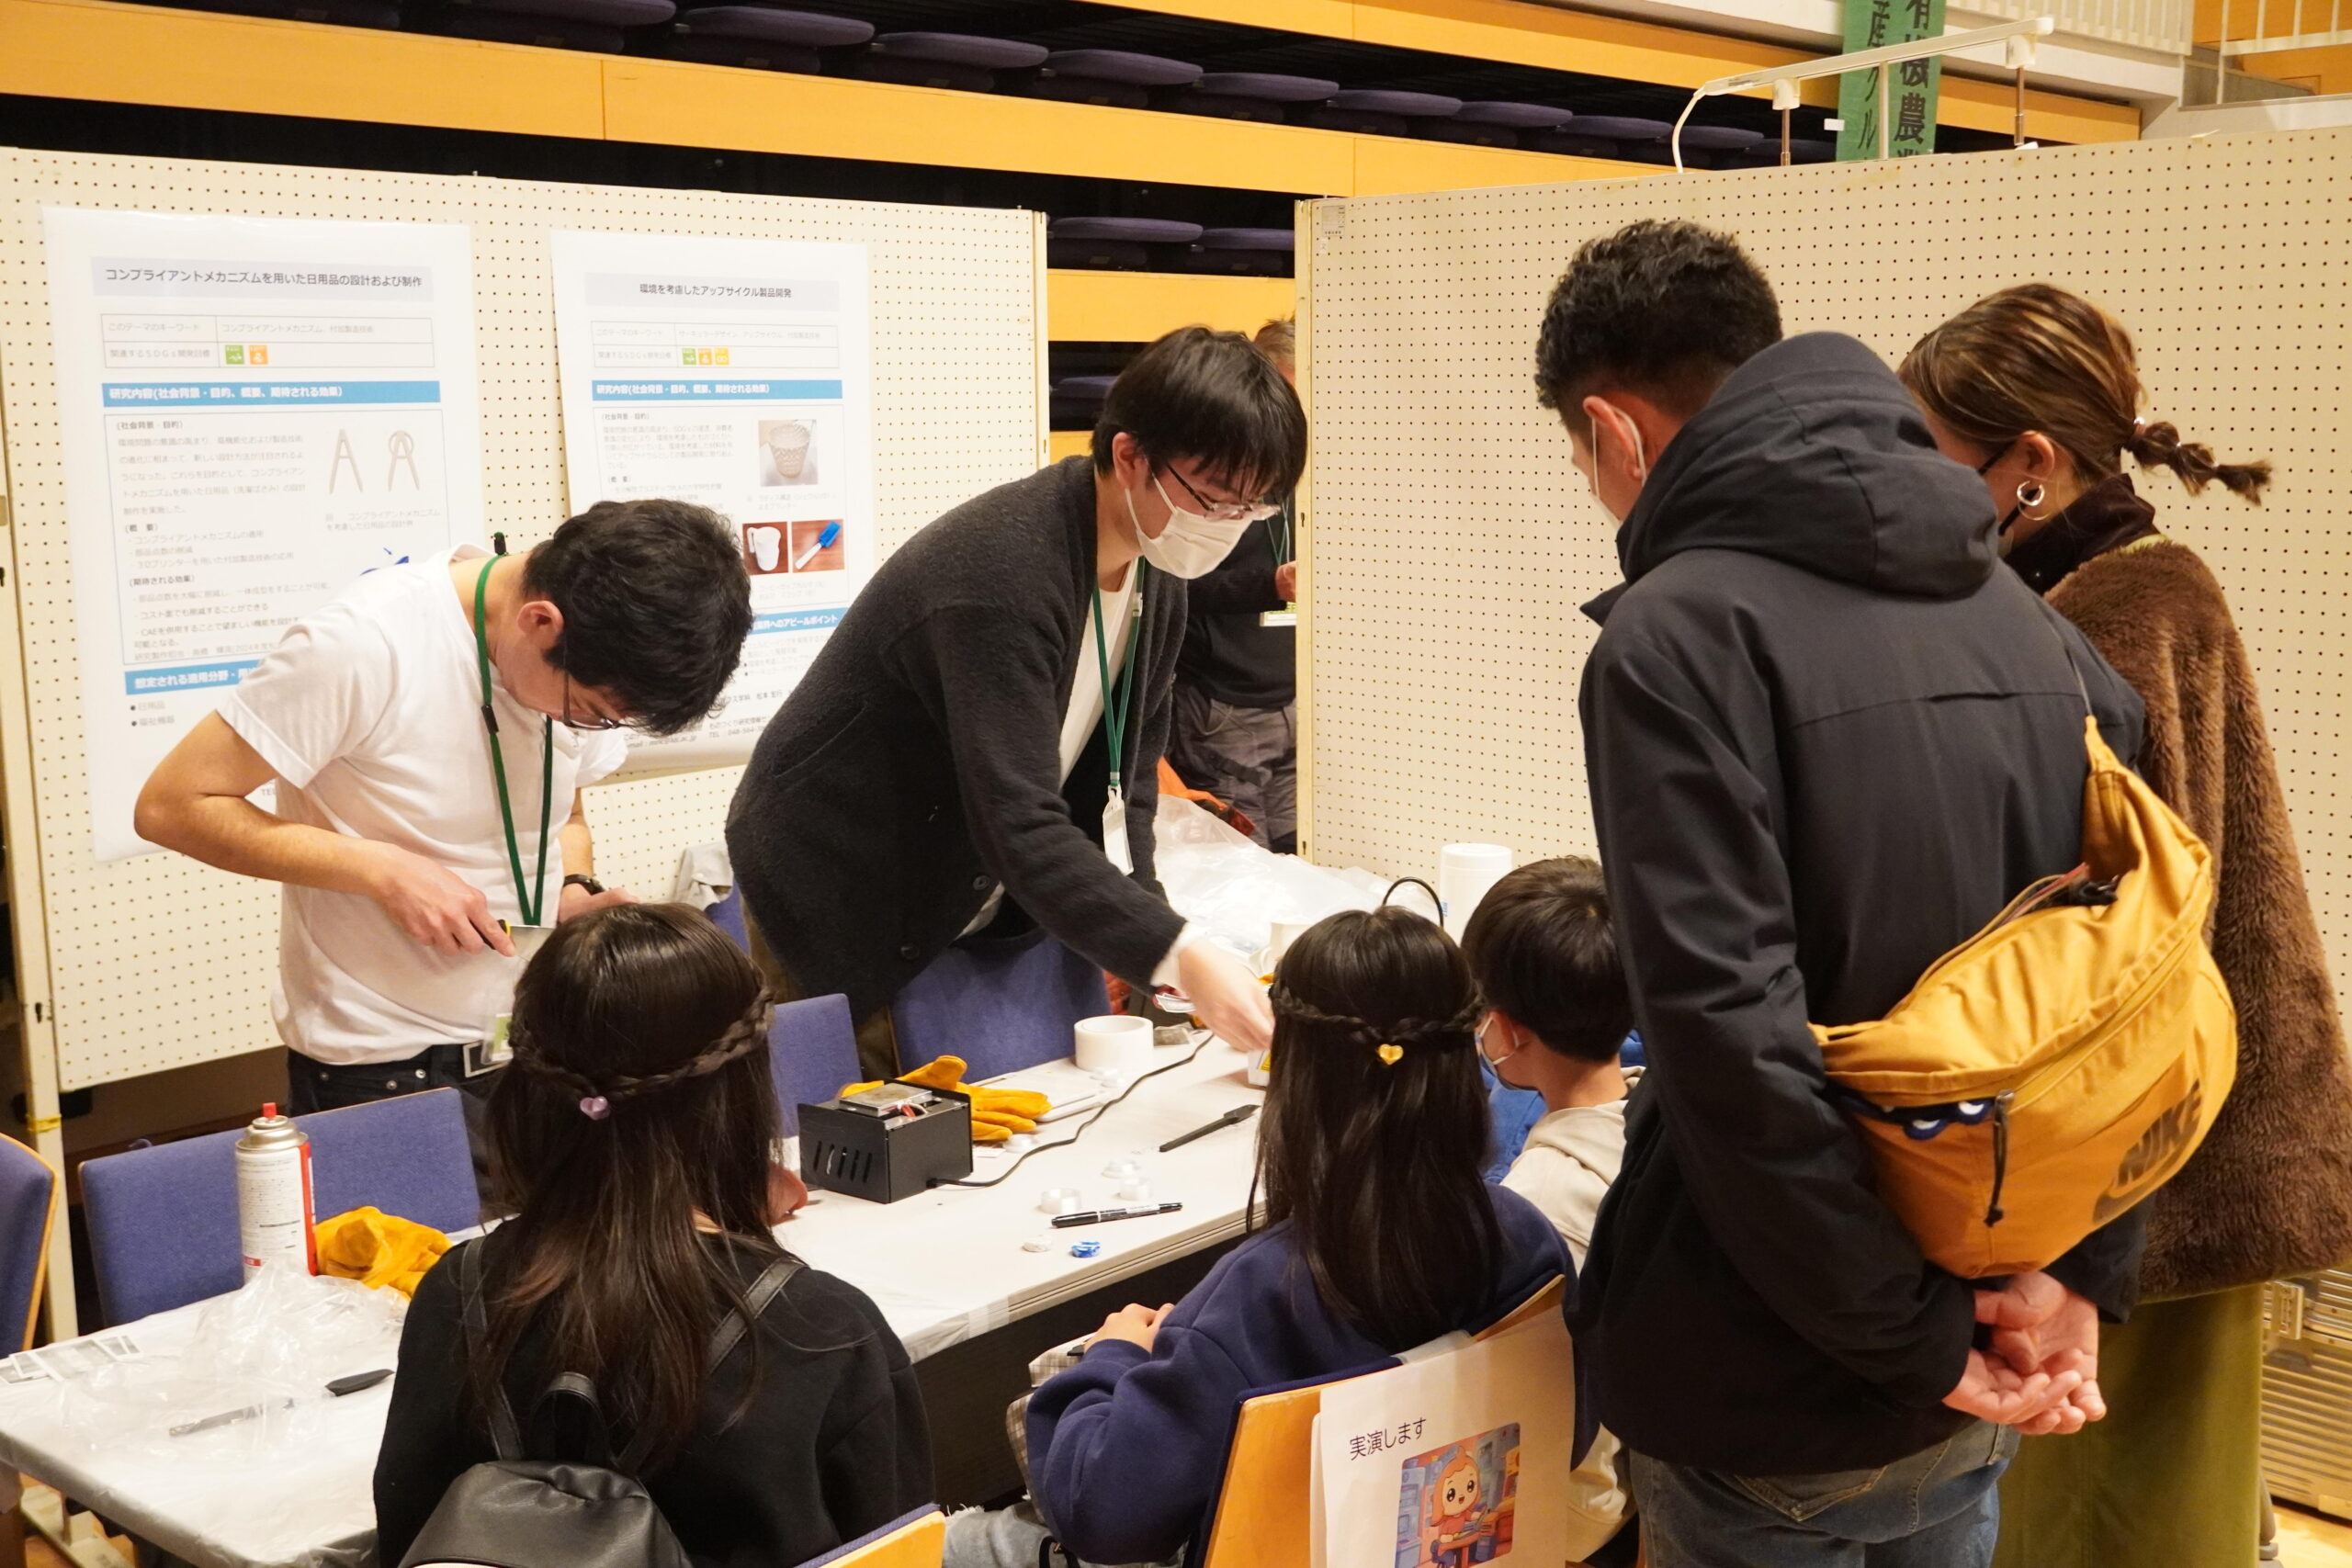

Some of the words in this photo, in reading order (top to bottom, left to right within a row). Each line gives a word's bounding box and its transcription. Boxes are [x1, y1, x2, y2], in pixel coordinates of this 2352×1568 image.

[105, 266, 423, 288] コンプライアントメカニズムを用いた日用品の設計および制作
[639, 283, 792, 299] 環境を考慮したアップサイクル製品開発
[2117, 1078, 2201, 1188] NIKE
[1349, 1416, 1427, 1461] 実演します
